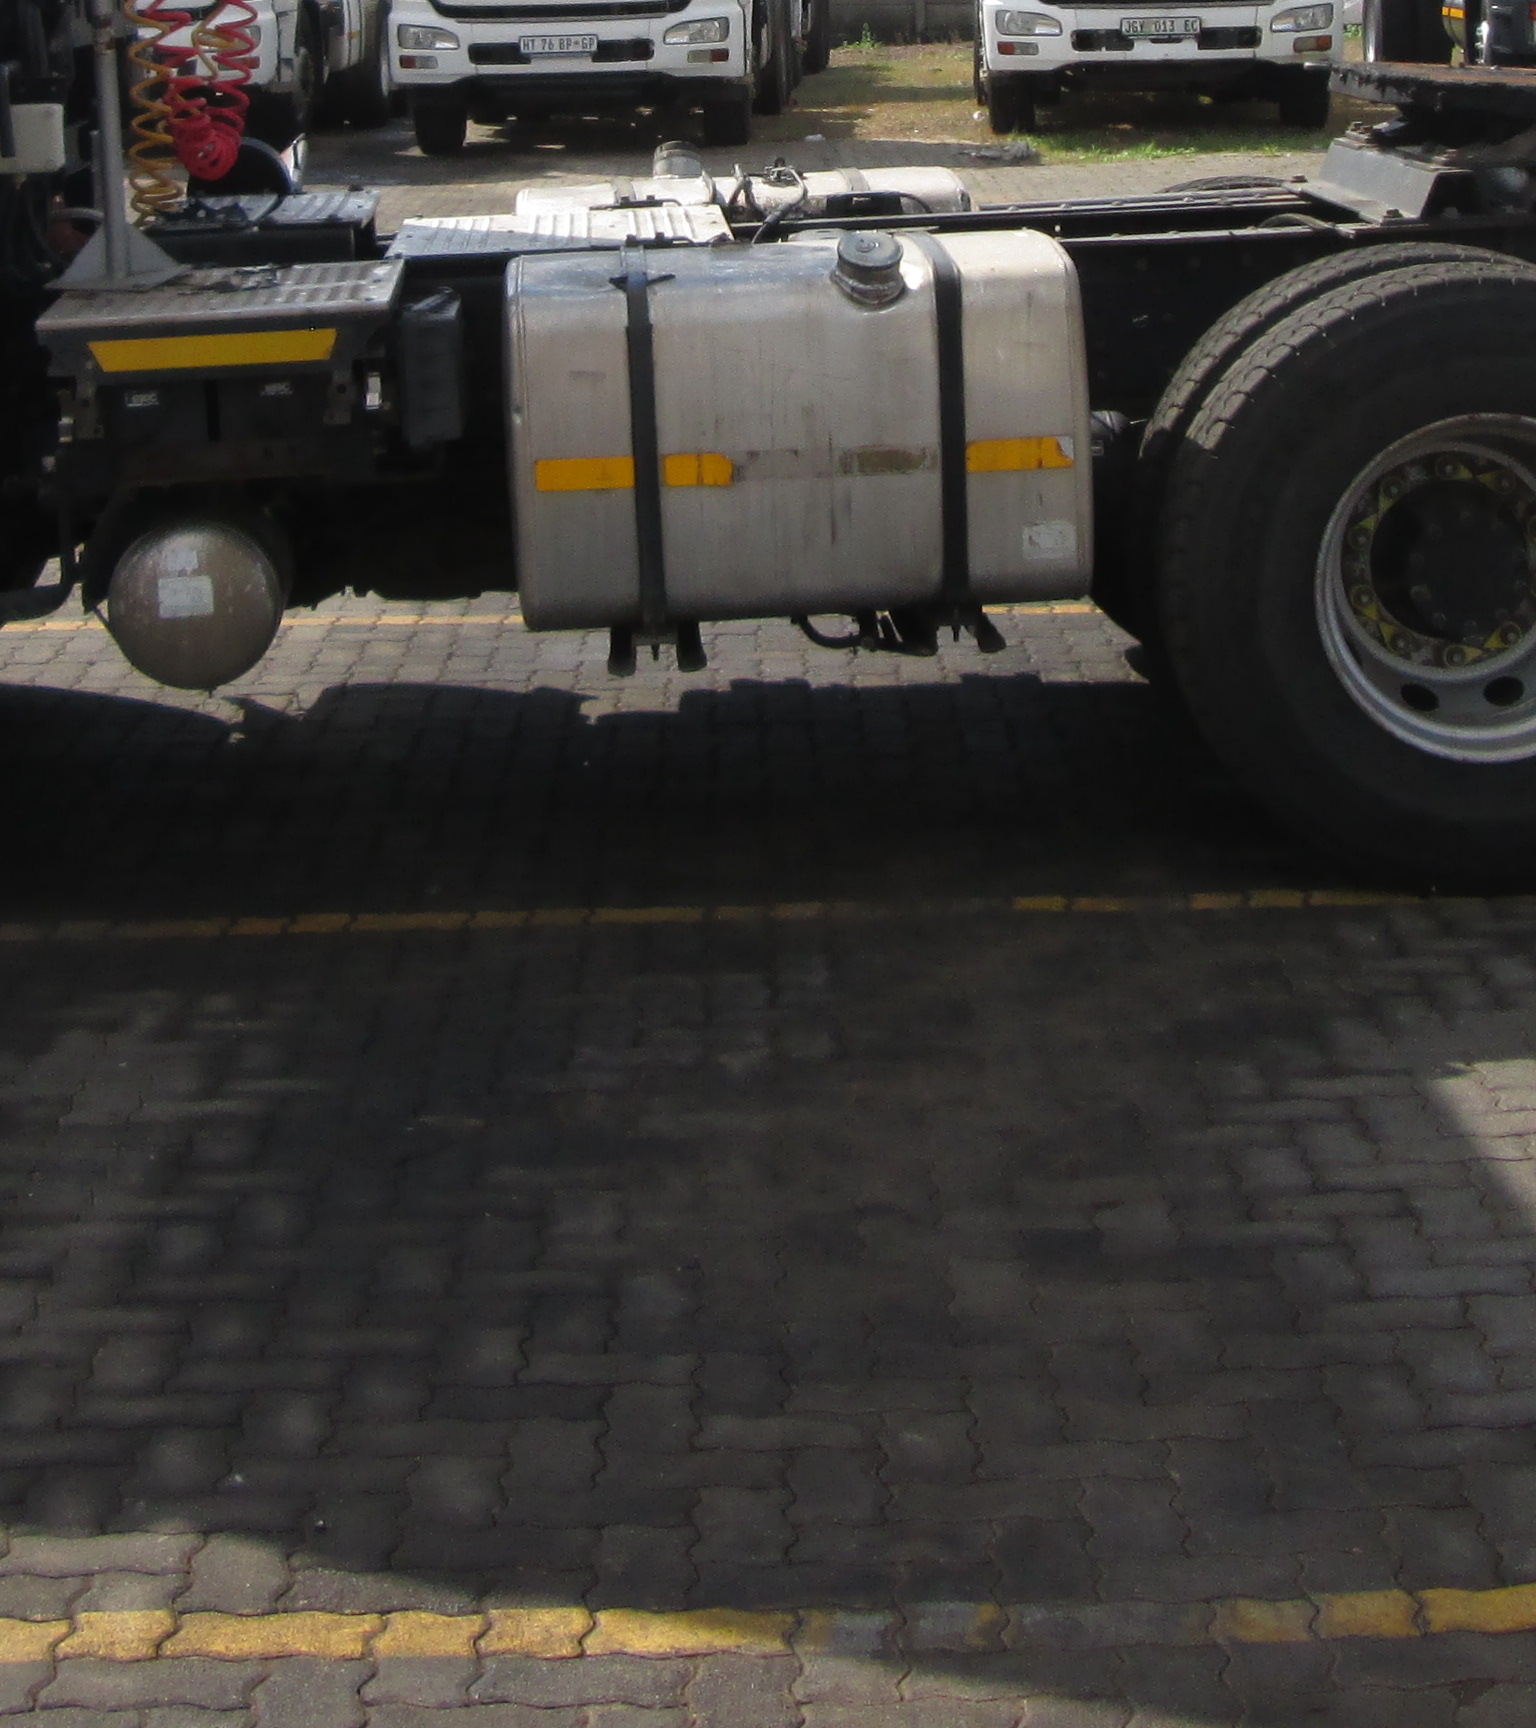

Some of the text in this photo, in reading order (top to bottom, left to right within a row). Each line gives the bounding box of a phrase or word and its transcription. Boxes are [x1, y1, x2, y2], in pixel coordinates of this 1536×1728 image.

[1153, 20, 1175, 33] 013
[1184, 19, 1199, 32] EC
[541, 38, 555, 50] 76
[581, 37, 595, 49] GP
